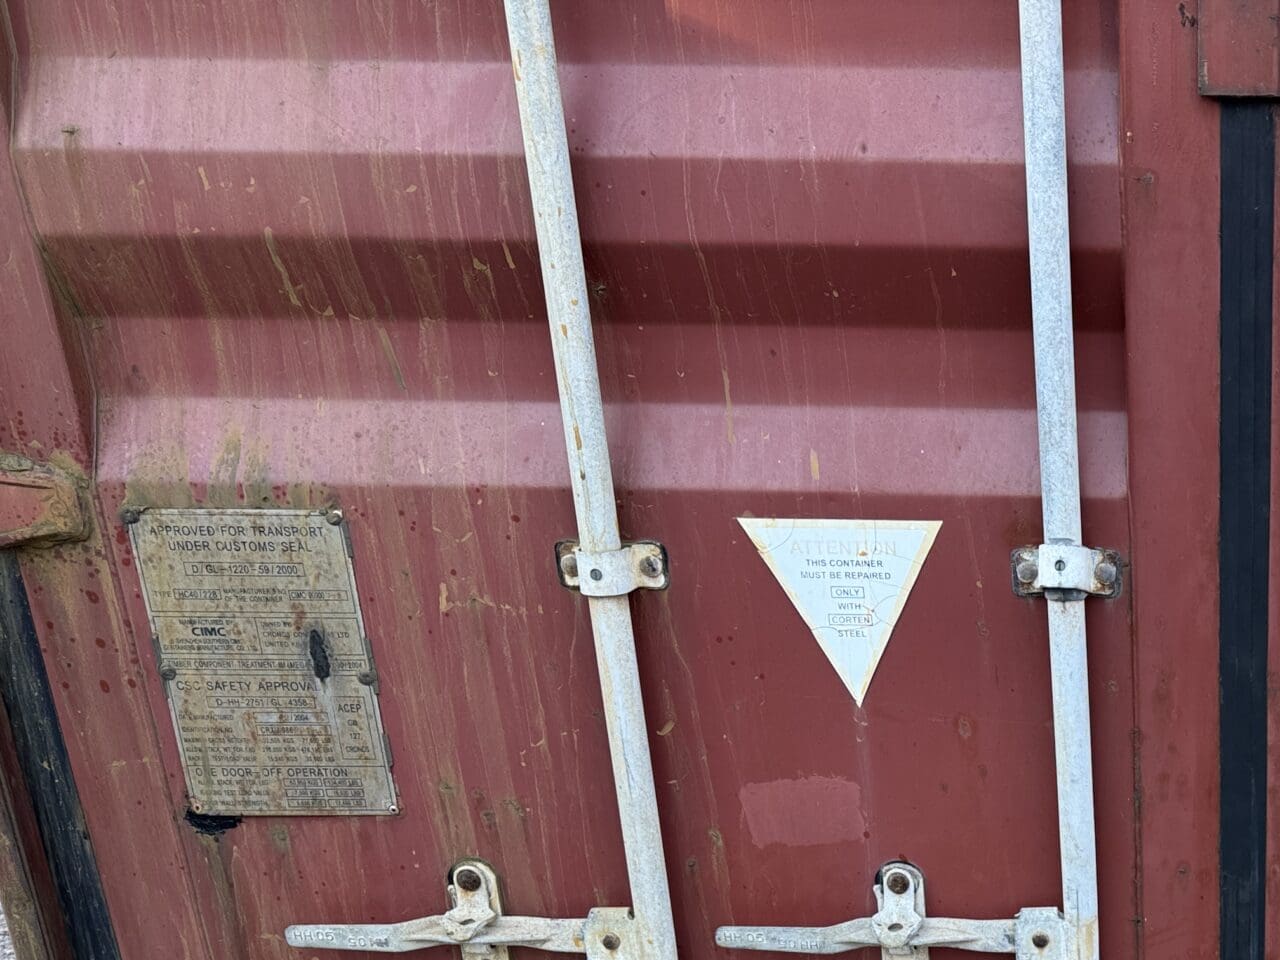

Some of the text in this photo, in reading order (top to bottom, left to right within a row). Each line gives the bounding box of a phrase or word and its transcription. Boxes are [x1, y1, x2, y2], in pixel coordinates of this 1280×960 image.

[150, 525, 323, 537] APPROVED FOR TRANSPORT
[169, 541, 313, 552] UNDER CUSTOMS SEAL
[790, 540, 897, 556] ATTENTION
[806, 559, 884, 568] THIS CONTAINER
[800, 571, 891, 580] MUST BE REPAIRED
[835, 588, 860, 596] ONLY
[838, 602, 861, 610] WITH
[831, 616, 870, 624] CORTEN
[192, 627, 226, 636] CIMC
[838, 629, 867, 638] STEEL
[176, 681, 320, 691] CSC SAFETY APPROVAL
[337, 703, 361, 712] ACEP
[287, 768, 348, 778] OPERATION
